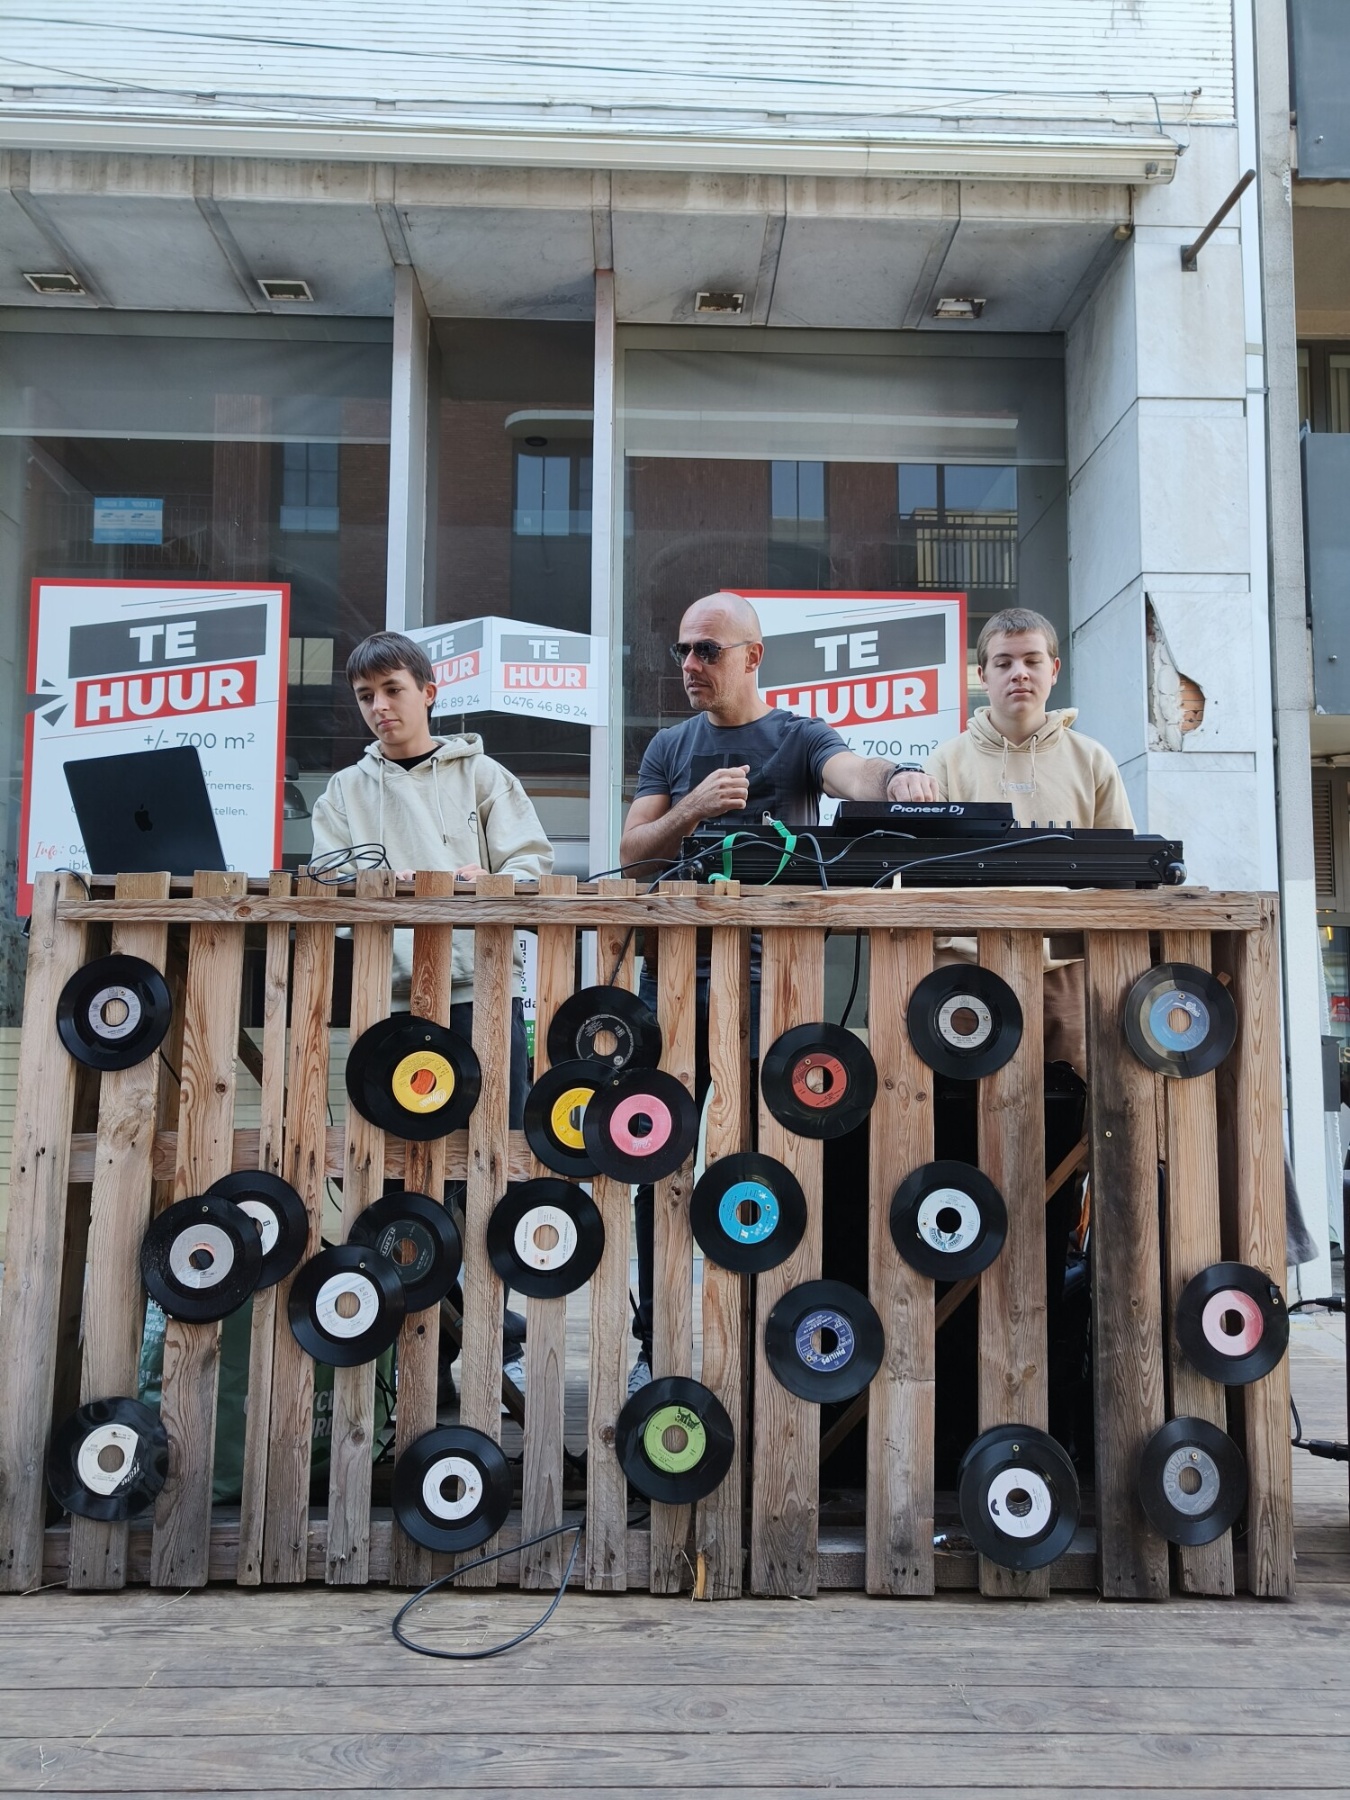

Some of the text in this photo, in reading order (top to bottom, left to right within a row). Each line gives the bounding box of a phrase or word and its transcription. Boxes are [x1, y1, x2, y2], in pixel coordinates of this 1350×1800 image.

[129, 620, 197, 663] TE
[427, 634, 455, 661] TE
[528, 639, 560, 660] TE
[814, 629, 880, 673] TE
[509, 665, 582, 688] HUUR
[85, 668, 244, 722] HUUR
[450, 696, 464, 708] 89
[466, 694, 481, 706] 24
[503, 694, 589, 718] 0476 46 89 24
[776, 677, 926, 725] HUUR
[176, 731, 217, 749] 700
[862, 740, 903, 756] 700
[889, 804, 947, 814] Pioneer
[821, 1348, 847, 1366] PHILIPS
